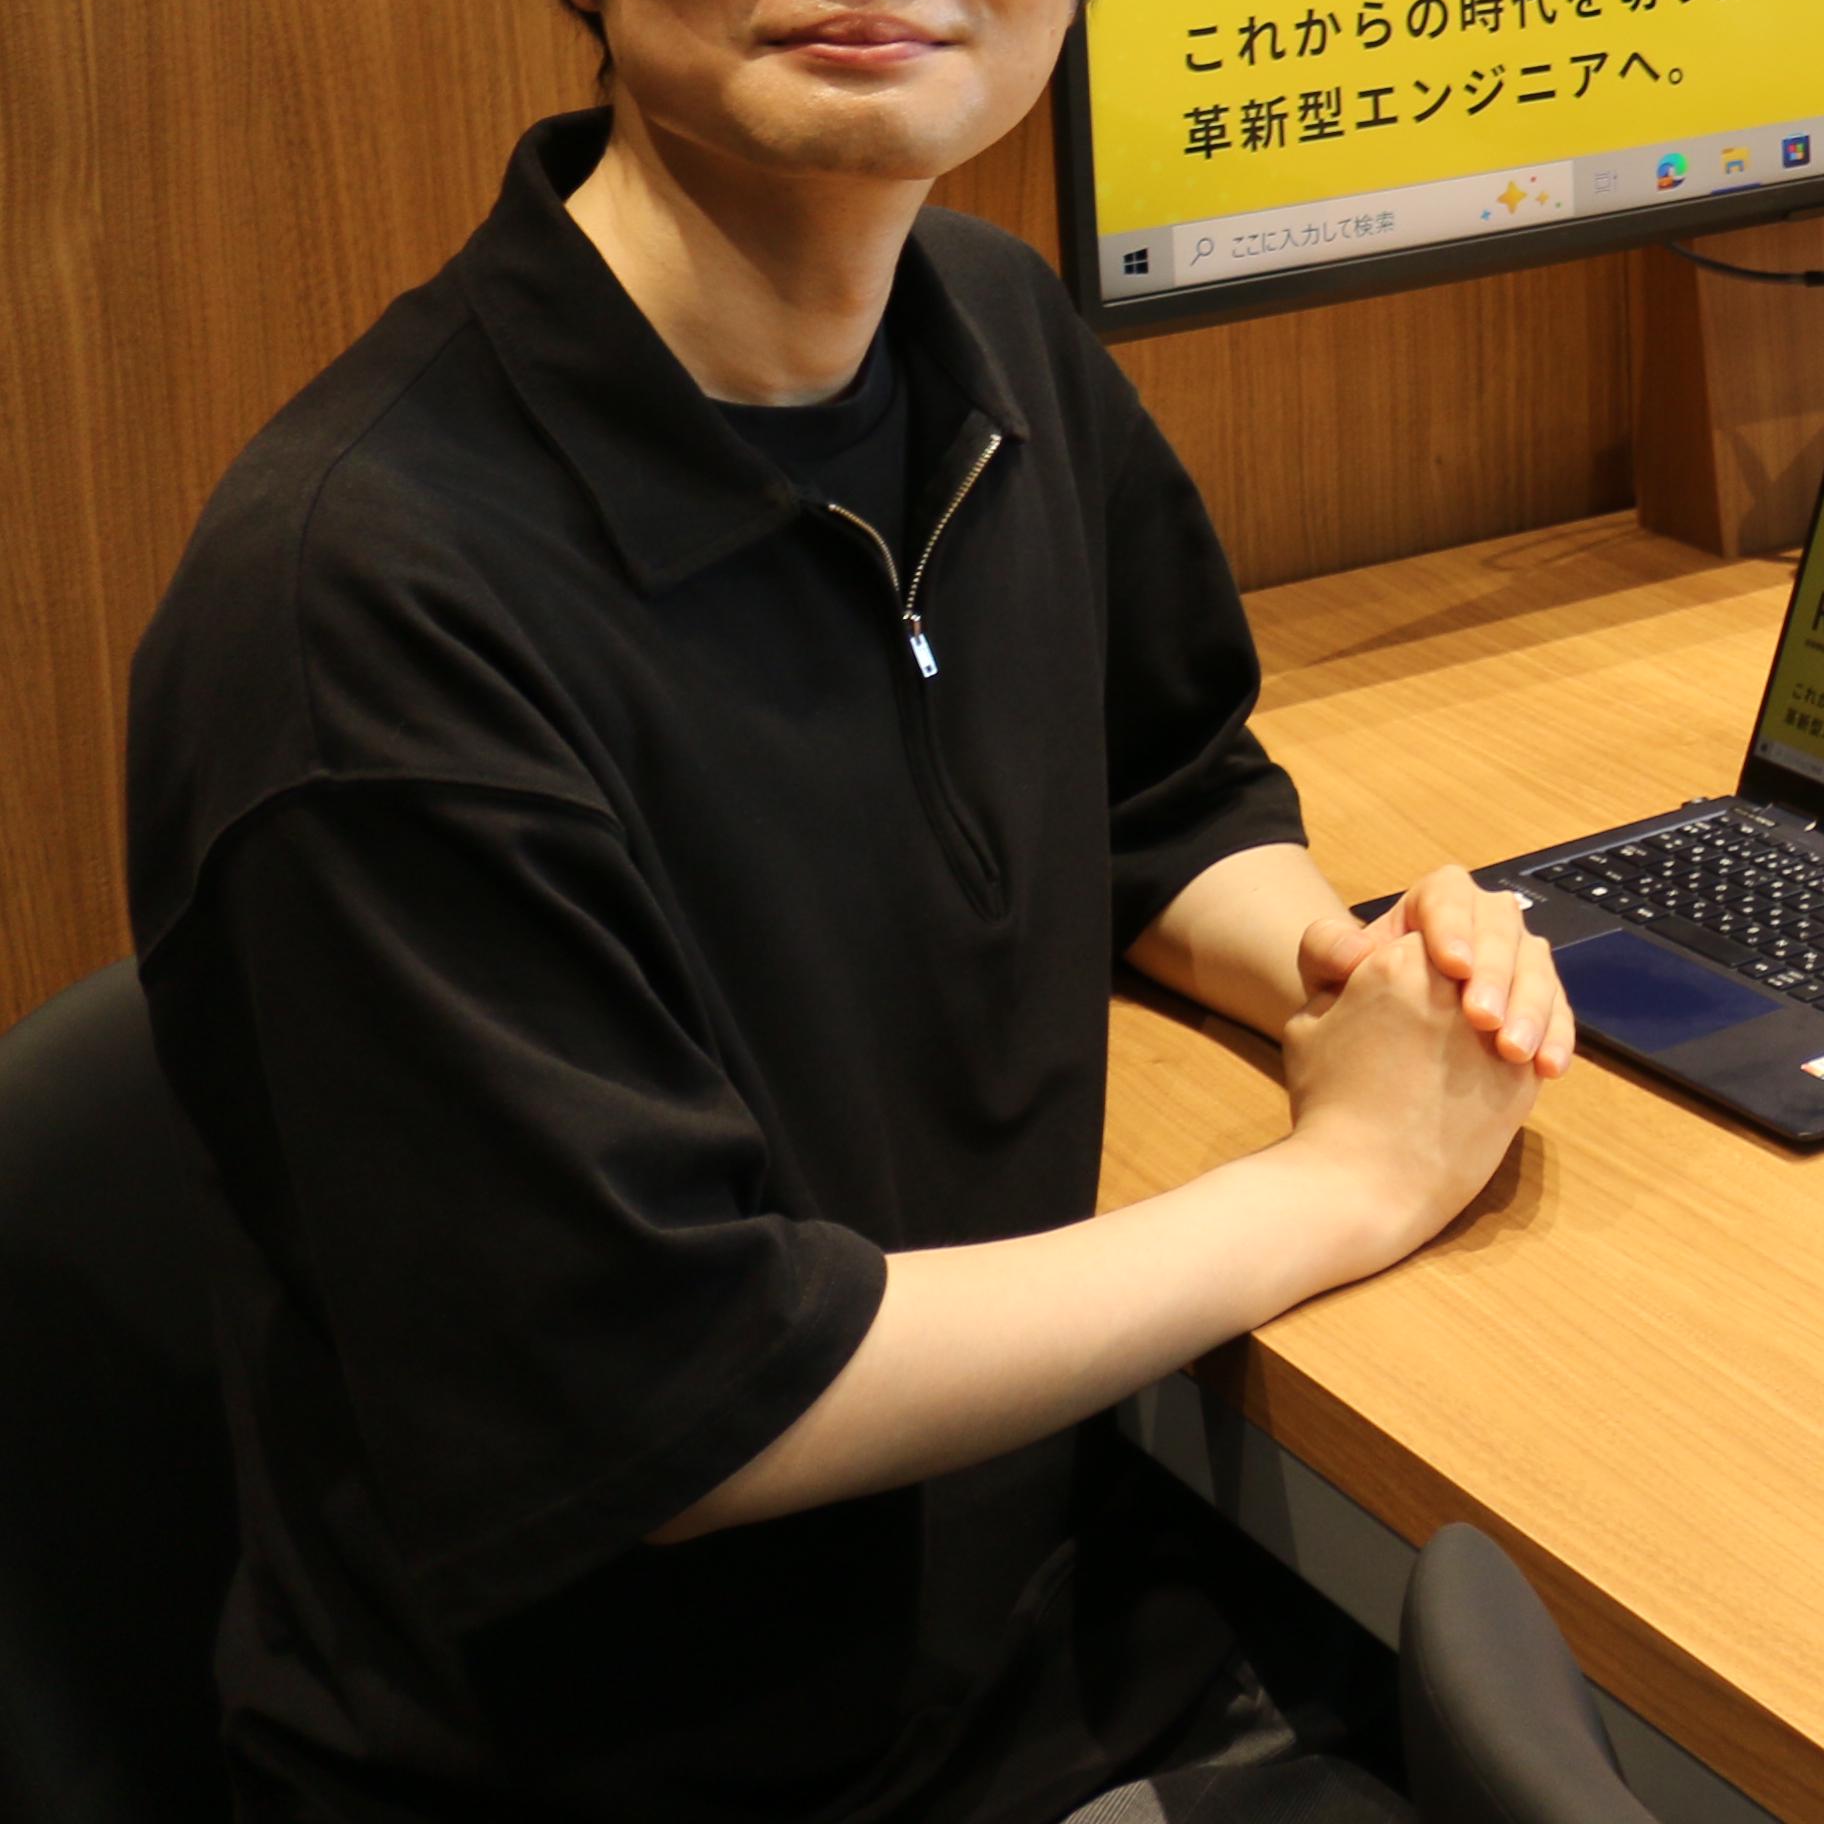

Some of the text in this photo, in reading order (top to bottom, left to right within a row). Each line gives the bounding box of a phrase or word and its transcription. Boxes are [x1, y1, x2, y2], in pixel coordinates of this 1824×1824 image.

[1183, 49, 1686, 160] 革新型エンジニアへ。
[1232, 211, 1395, 259] ここに入力して検索
